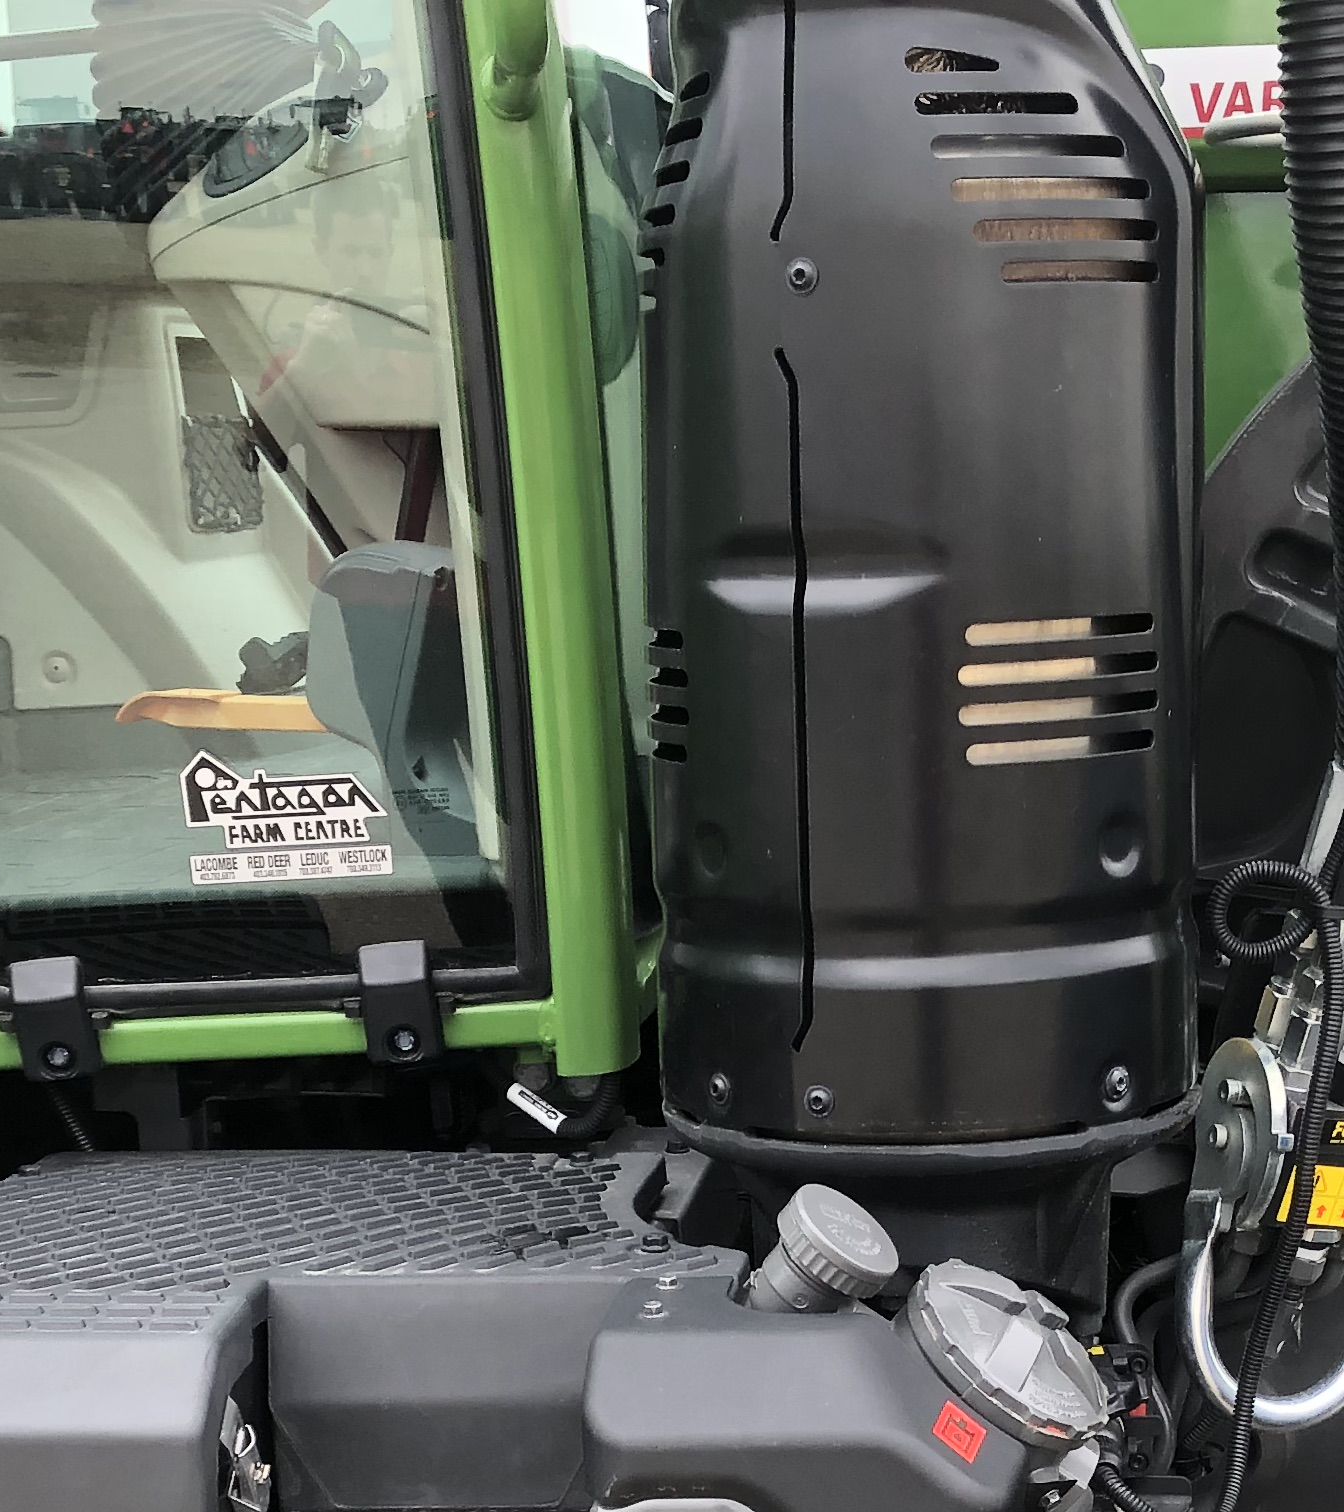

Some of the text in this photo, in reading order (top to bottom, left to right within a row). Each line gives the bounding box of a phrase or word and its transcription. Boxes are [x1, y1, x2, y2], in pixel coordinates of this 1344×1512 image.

[185, 756, 380, 822] Pentagon
[228, 818, 365, 845] FARM CENTRE
[194, 856, 239, 872] LACOMBE
[247, 853, 291, 869] RED DEER
[299, 852, 330, 867] LEDUC
[338, 849, 388, 865] WESTLOCK
